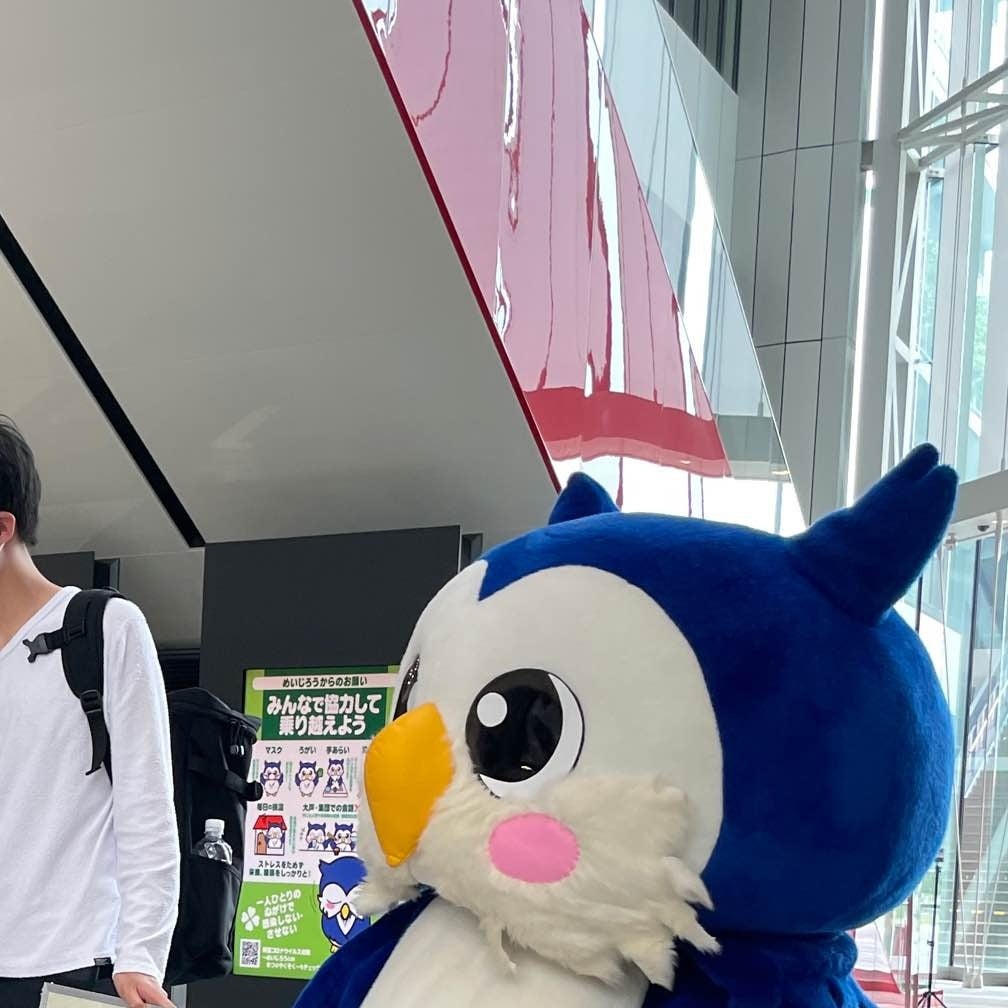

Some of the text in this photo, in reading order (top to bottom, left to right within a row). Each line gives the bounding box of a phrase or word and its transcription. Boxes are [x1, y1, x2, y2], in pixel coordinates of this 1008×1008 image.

[282, 676, 368, 688] めいじろうからのお願い
[266, 693, 382, 716] みんなで協力して
[278, 714, 366, 736] 乗り越えよう
[265, 746, 283, 754] マスク
[298, 746, 317, 754] うがい
[326, 746, 350, 754] 手あらい
[255, 889, 302, 907] 一人ひとりの
[266, 924, 298, 940] させない
